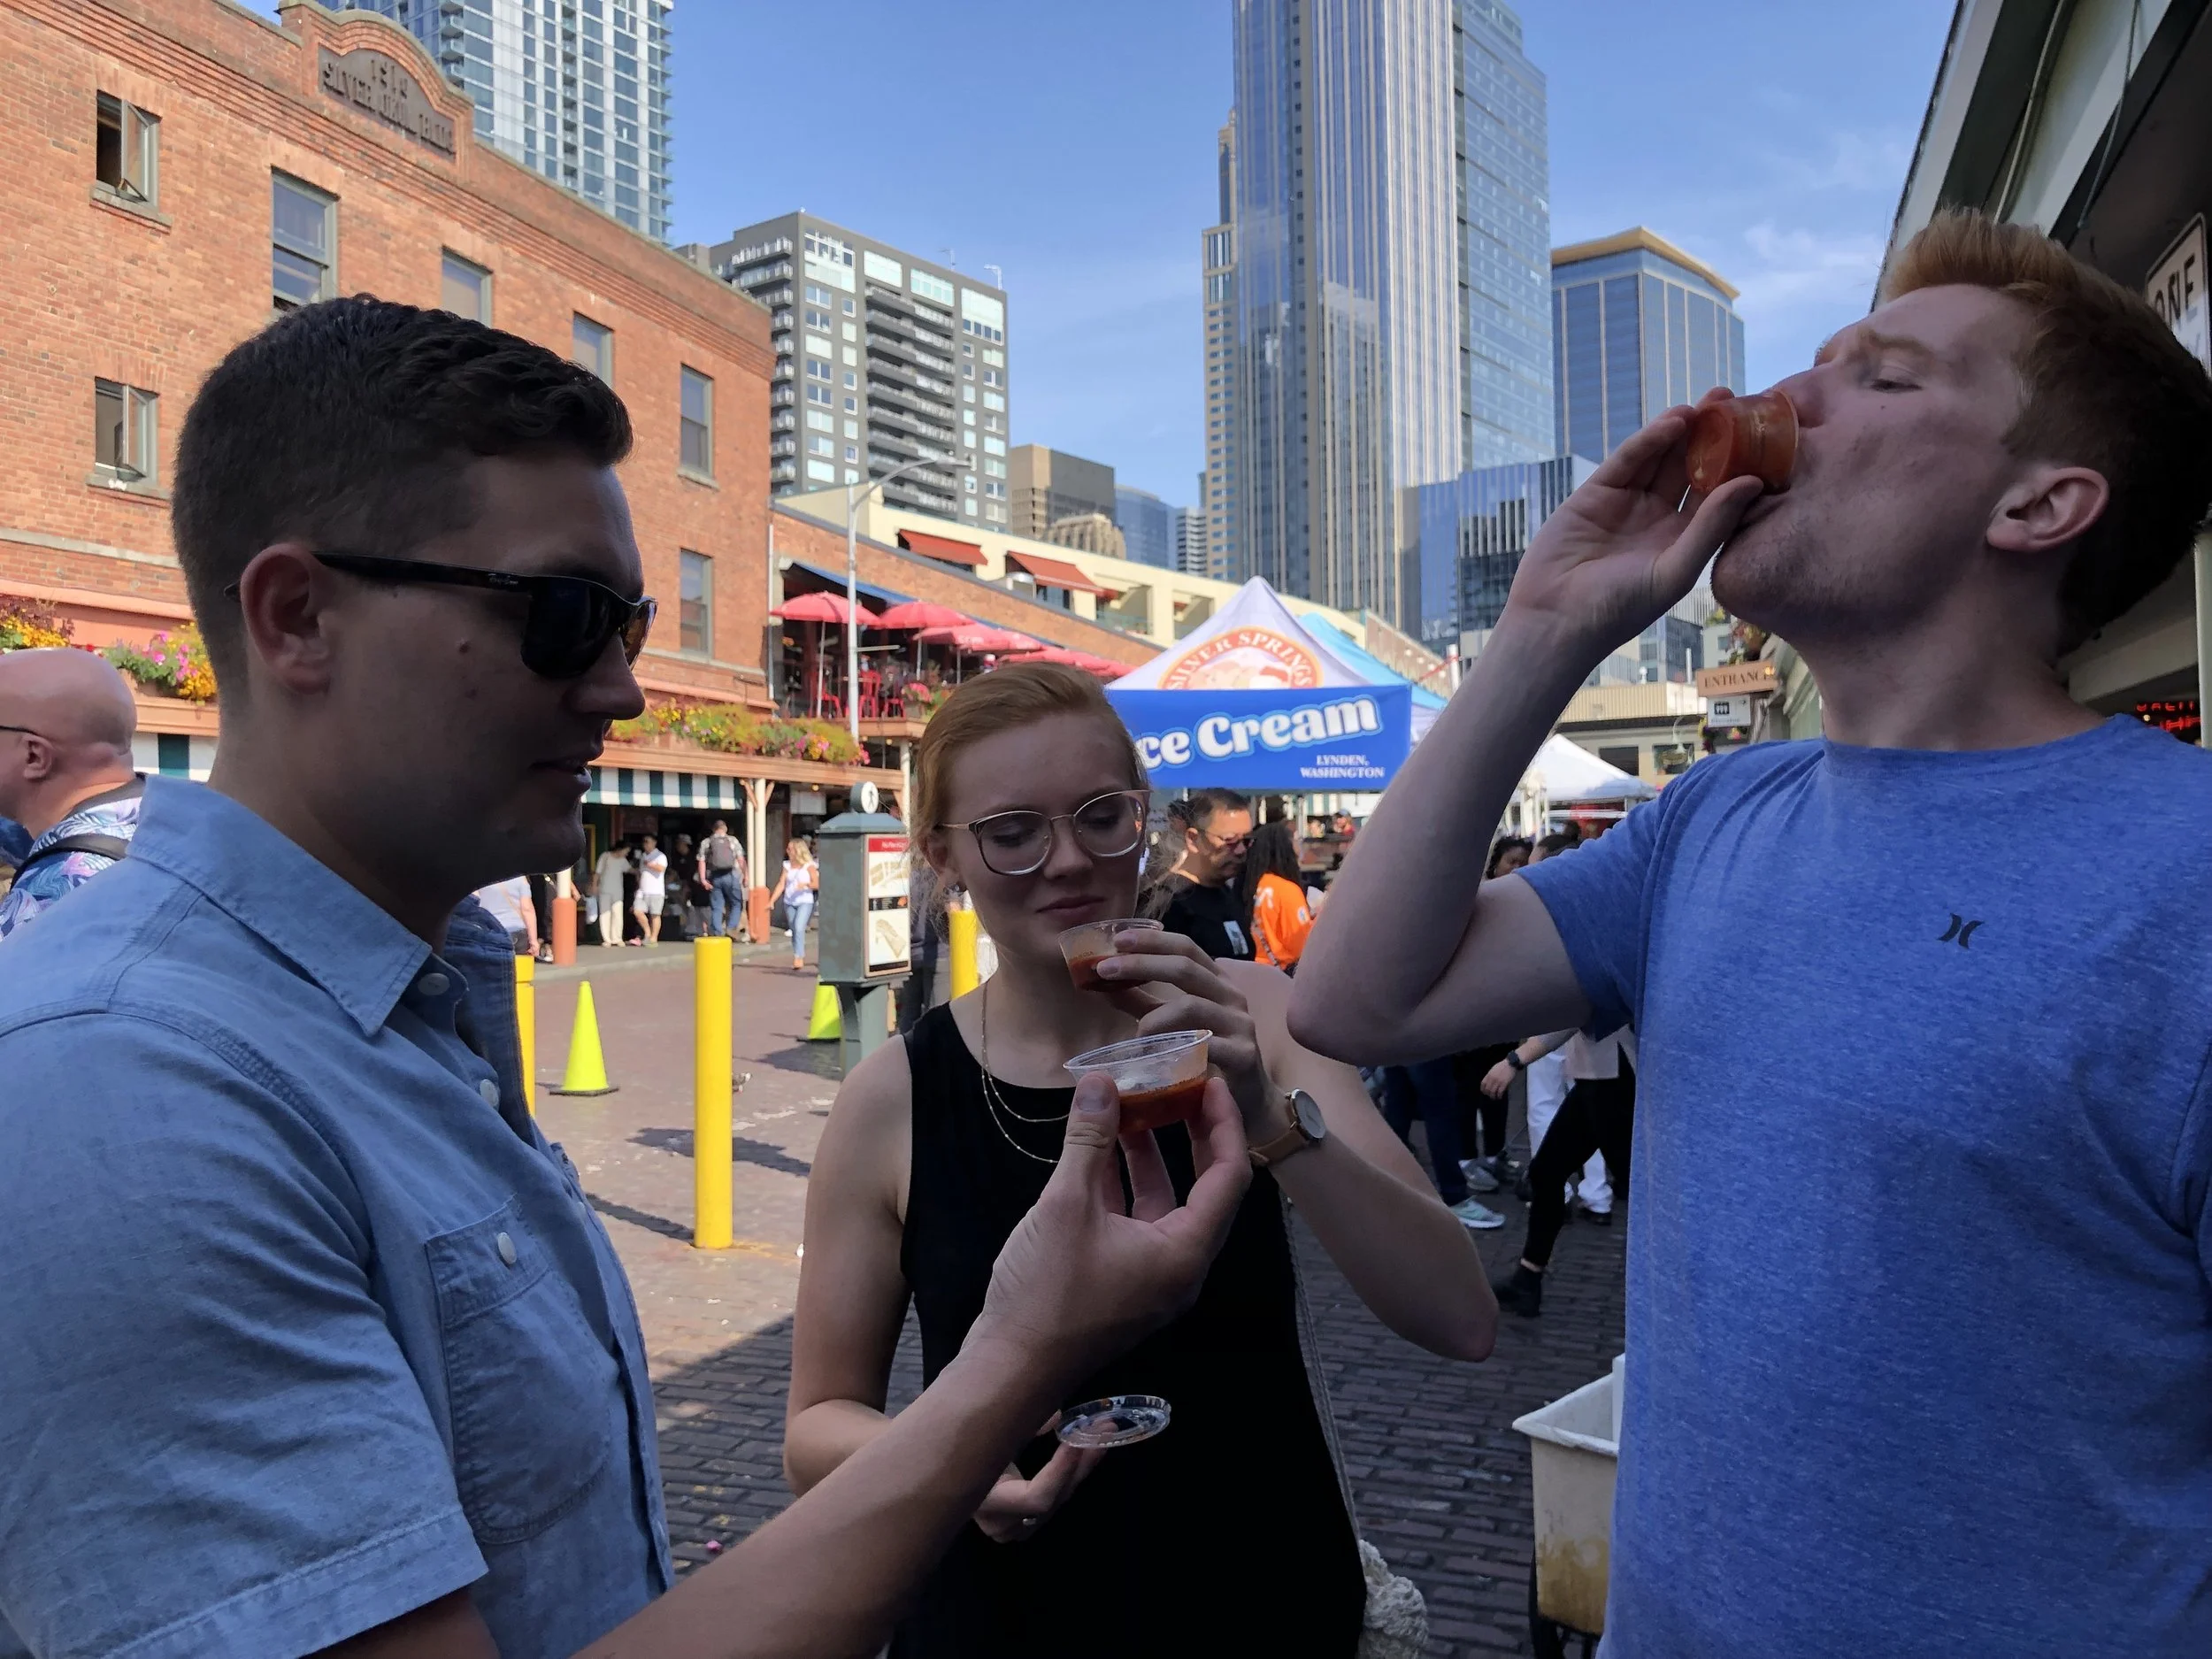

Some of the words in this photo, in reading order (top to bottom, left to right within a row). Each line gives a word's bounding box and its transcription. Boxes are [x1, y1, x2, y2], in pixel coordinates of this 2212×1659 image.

[1170, 637, 1232, 689] SILVER
[1238, 632, 1313, 687] SPRINGS
[1135, 731, 1191, 770] ce
[1197, 697, 1379, 758] Cream
[1300, 766, 1385, 779] WASHINGTON
